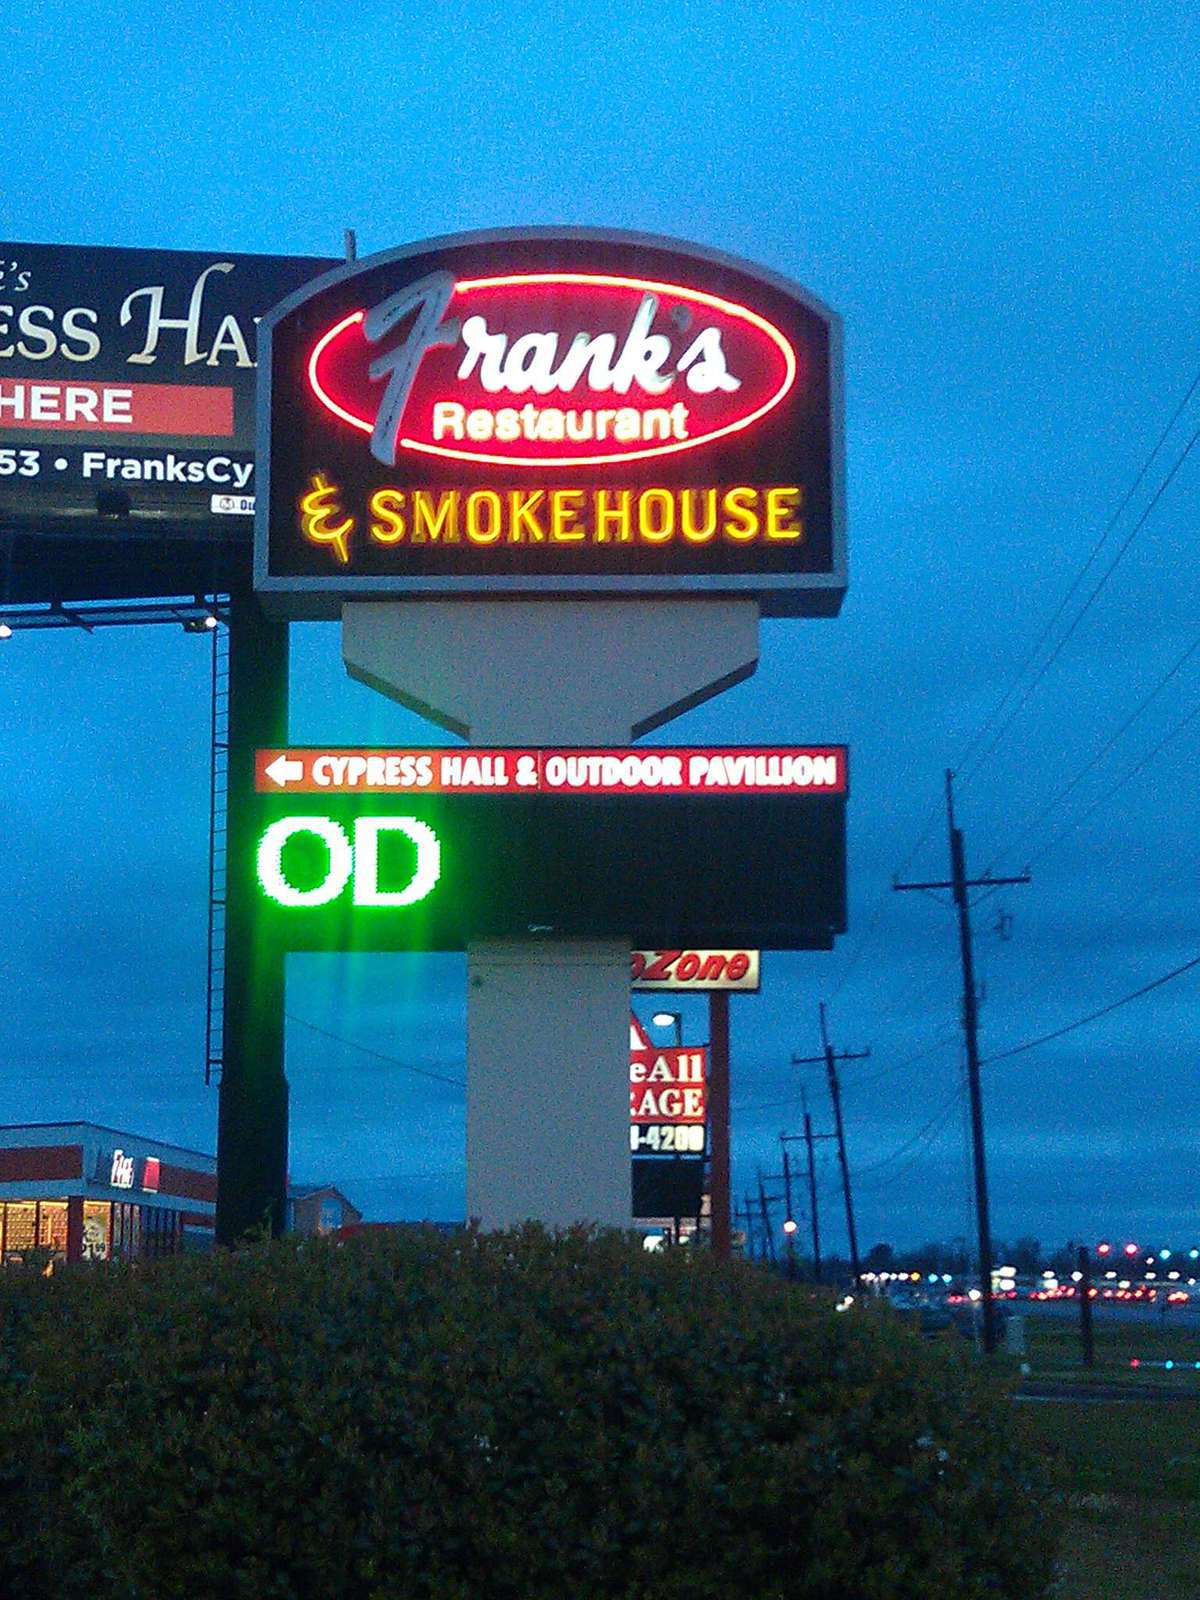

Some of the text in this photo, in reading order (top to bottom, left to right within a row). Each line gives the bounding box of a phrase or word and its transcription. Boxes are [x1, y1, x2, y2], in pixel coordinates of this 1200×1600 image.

[363, 270, 742, 467] Frank's
[431, 401, 690, 444] Restaurant
[300, 470, 803, 565] & SMOKEHOUSE
[311, 755, 837, 787] CYPRESS HALL & OUTDOOR PAVILLION
[256, 815, 441, 908] OD
